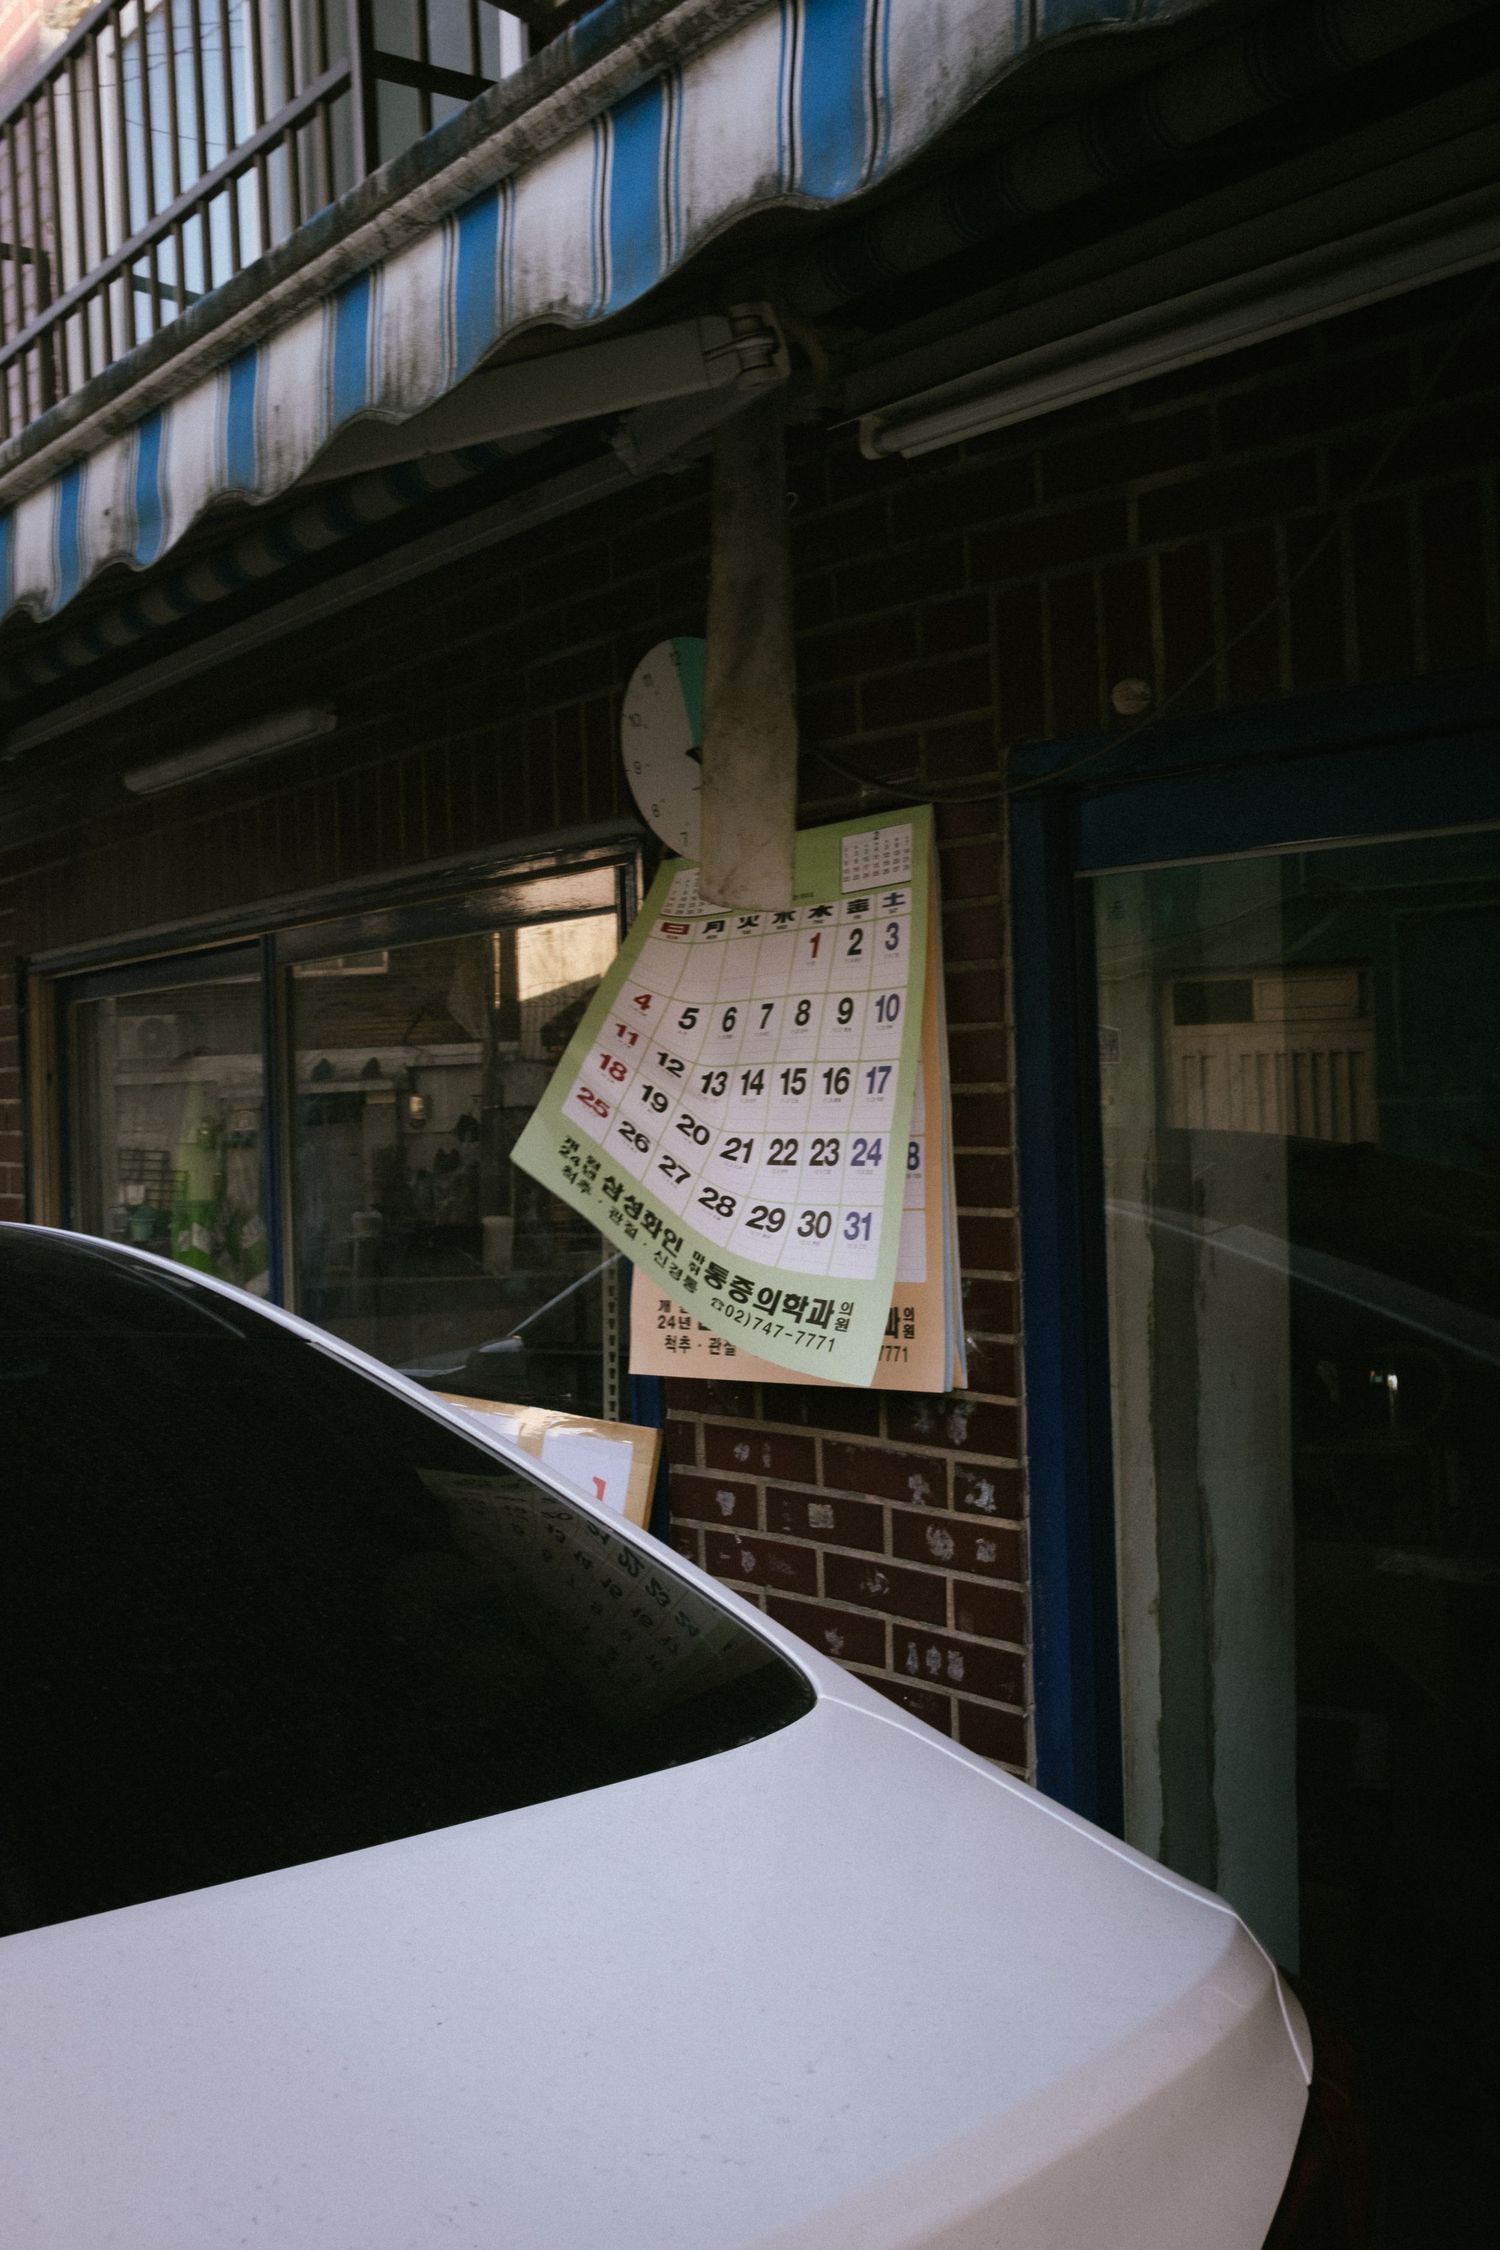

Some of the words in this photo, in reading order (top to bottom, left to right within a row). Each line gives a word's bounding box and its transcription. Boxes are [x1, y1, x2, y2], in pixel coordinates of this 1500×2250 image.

[651, 803, 660, 818] 8
[702, 919, 726, 935] 月
[737, 914, 759, 930] 火
[772, 911, 796, 925] 水
[808, 905, 833, 919] 木
[882, 892, 906, 908] 土
[809, 932, 821, 959] 1
[847, 928, 864, 956] 2
[885, 922, 900, 951] 3
[633, 993, 652, 1011] 4
[678, 1007, 700, 1030] 5
[722, 1006, 738, 1032] 6
[759, 1002, 775, 1030] 7
[794, 999, 812, 1026] 8
[836, 997, 854, 1025] 9
[875, 993, 901, 1023] 10
[615, 1023, 640, 1047] 11
[656, 1051, 686, 1079] 12
[700, 1071, 728, 1097] 13
[740, 1068, 765, 1096] 14
[780, 1067, 807, 1096] 15
[822, 1066, 851, 1095] 16
[866, 1065, 892, 1094] 17
[599, 1053, 628, 1082] 18
[641, 1084, 669, 1113] 19
[675, 1113, 711, 1146] 20
[719, 1137, 754, 1164] 21
[766, 1138, 799, 1166] 22
[809, 1137, 840, 1167] 23
[850, 1137, 883, 1167] 24
[576, 1086, 611, 1119] 25
[618, 1120, 650, 1154] 26
[658, 1154, 692, 1185] 27
[697, 1186, 737, 1218] 28
[745, 1205, 786, 1233] 29
[797, 1210, 832, 1239] 30
[843, 1211, 873, 1241] 31
[602, 1175, 684, 1258] 삼성화인
[704, 1261, 836, 1330] 통증의학과
[657, 1315, 692, 1330] 24년
[664, 1334, 692, 1354] 척추
